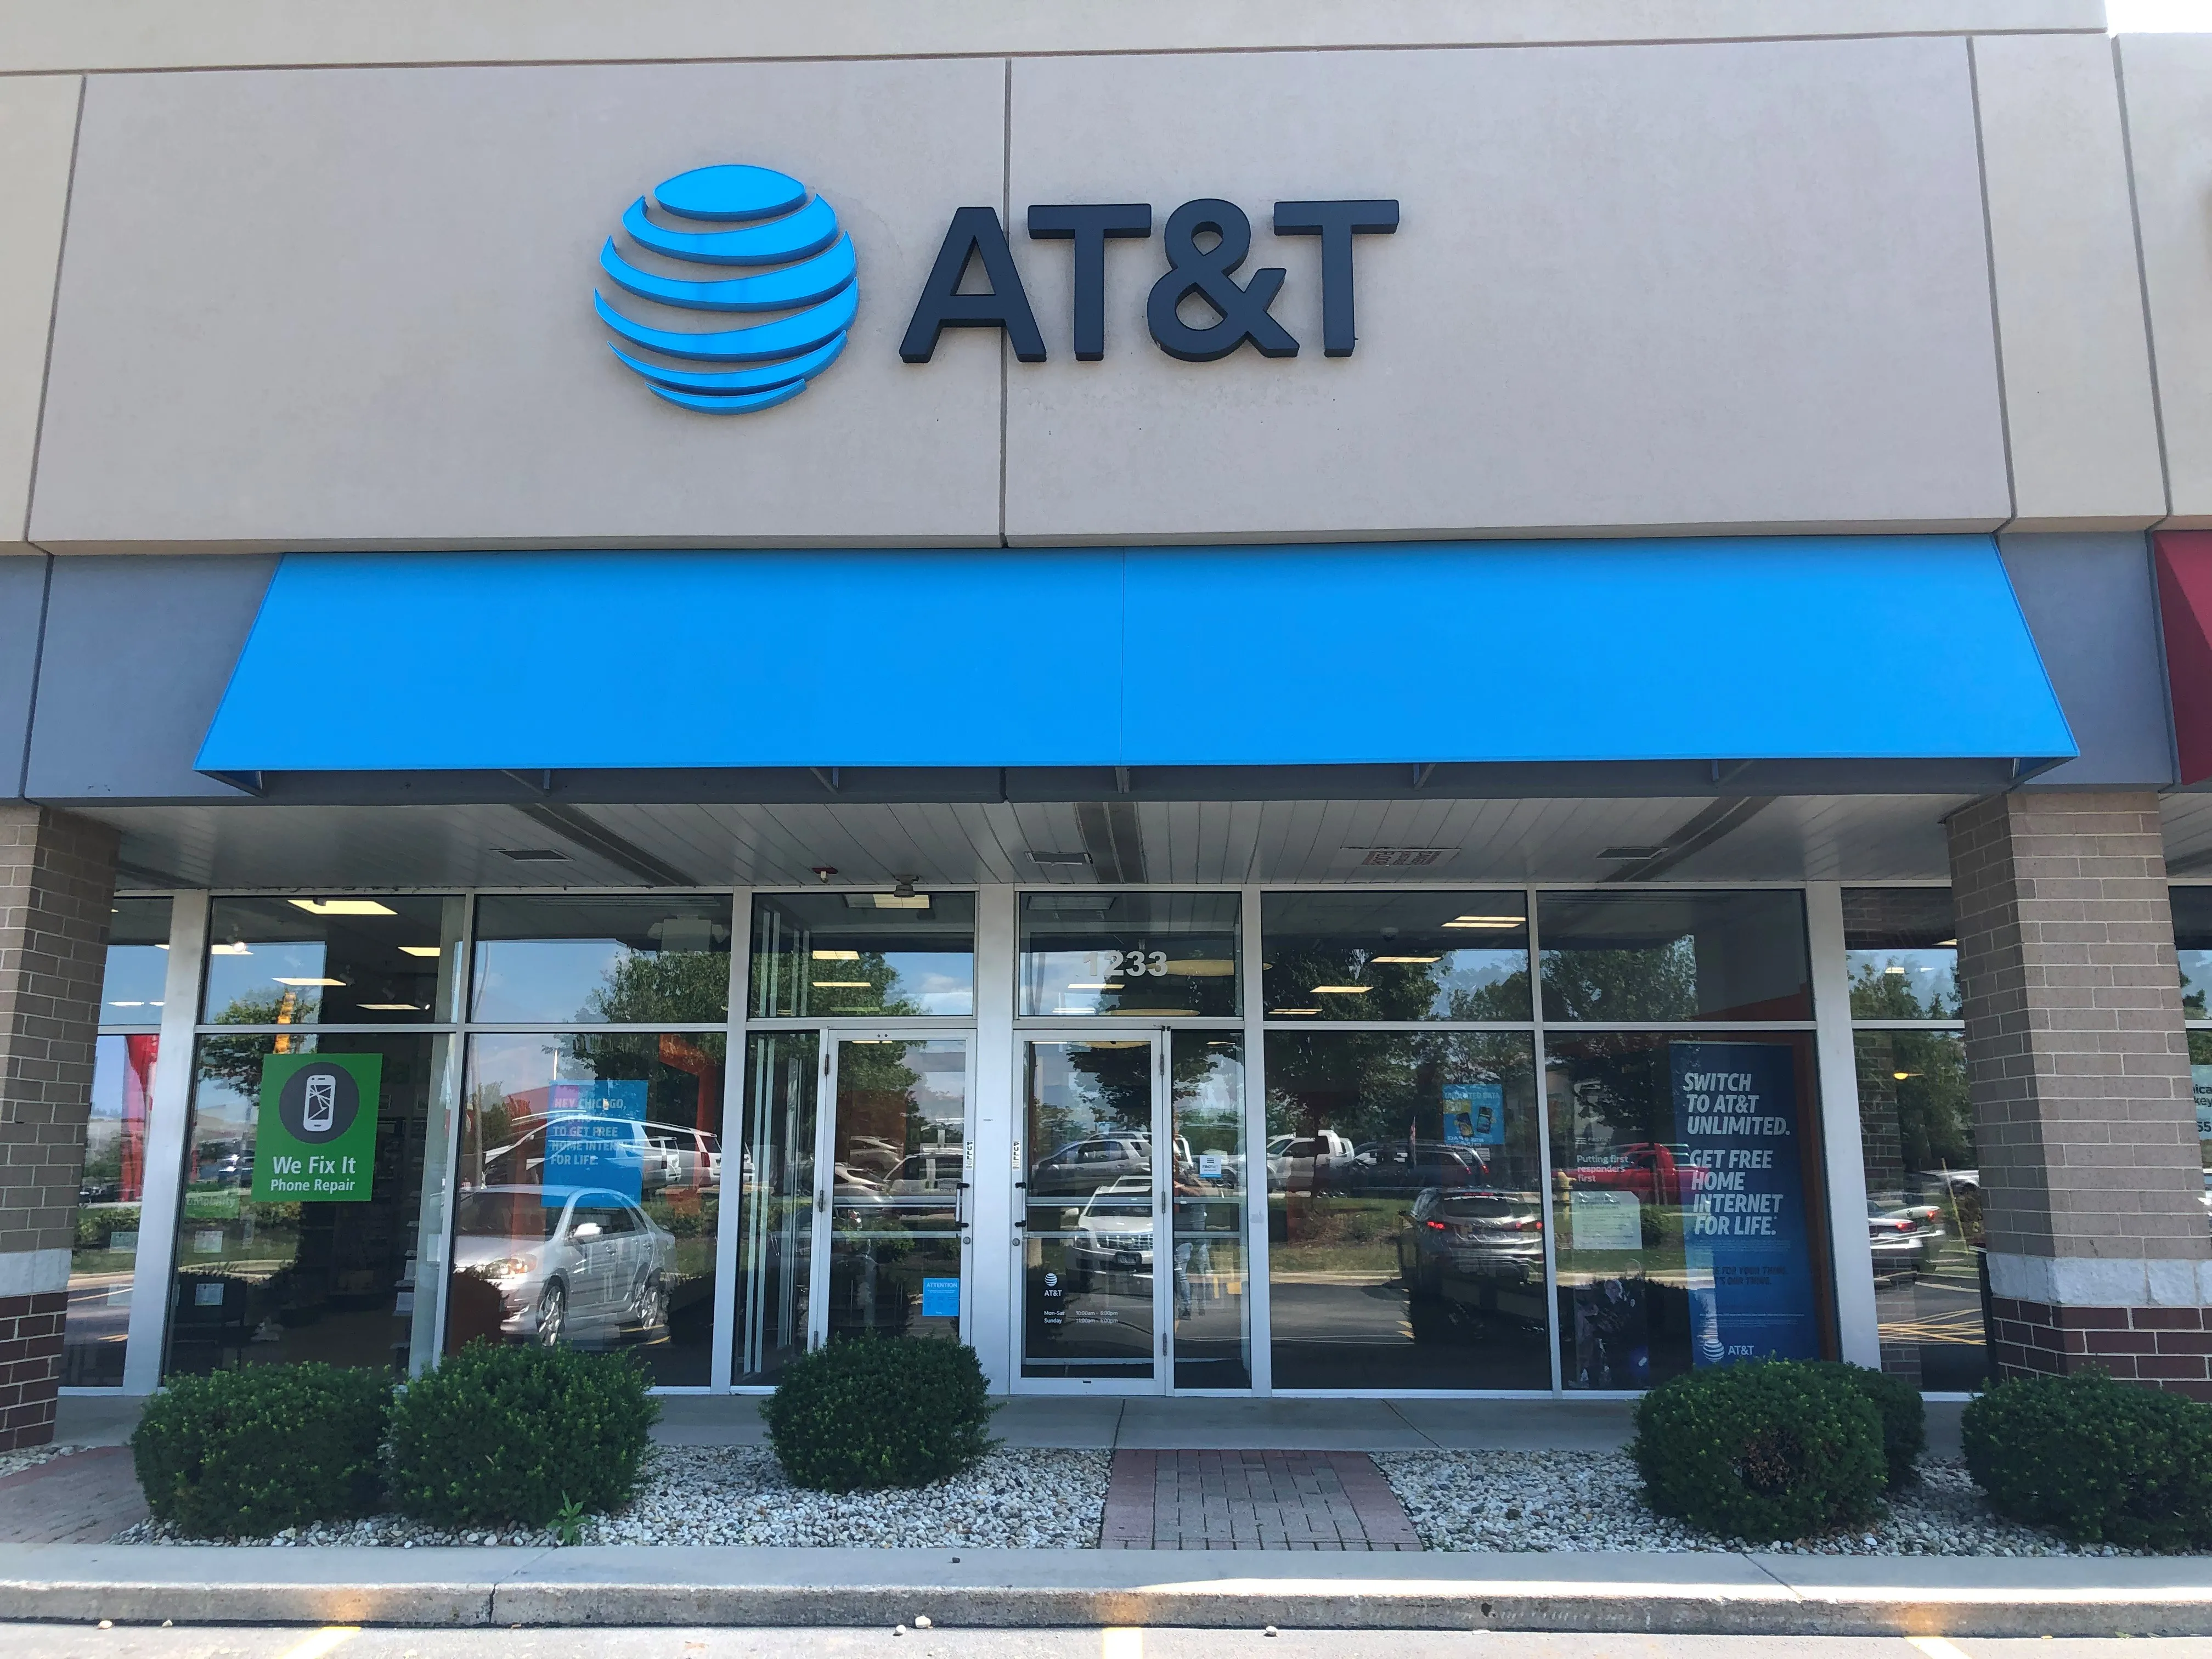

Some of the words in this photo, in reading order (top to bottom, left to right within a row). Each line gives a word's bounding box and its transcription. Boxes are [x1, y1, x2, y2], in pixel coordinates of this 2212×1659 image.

[899, 198, 1399, 362] AT&T
[1083, 950, 1167, 976] 1233
[1683, 1073, 1752, 1091] SWITCH
[554, 1098, 575, 1108] HEY
[578, 1098, 627, 1110] CHICGO,
[1686, 1094, 1710, 1113] TO
[1713, 1095, 1759, 1113] AT&T
[552, 1126, 567, 1136] TO
[569, 1126, 590, 1137] GET
[593, 1126, 618, 1137] FREE
[1688, 1116, 1790, 1136] UNLIMITED.
[551, 1141, 583, 1151] HOME
[273, 1156, 302, 1173] We
[308, 1155, 336, 1173] Fix
[342, 1156, 357, 1173] It
[550, 1154, 571, 1165] FOR
[1577, 1155, 1609, 1164] Putting
[1690, 1149, 1725, 1168] GET
[1729, 1150, 1773, 1168] FREE
[1577, 1165, 1626, 1173] responders
[270, 1178, 311, 1191] Phone
[314, 1178, 356, 1194] Repair
[1691, 1171, 1746, 1190] HOME
[1693, 1194, 1783, 1213] INTERNET
[1694, 1216, 1730, 1235] FOR
[1728, 1345, 1754, 1355] AT&T
